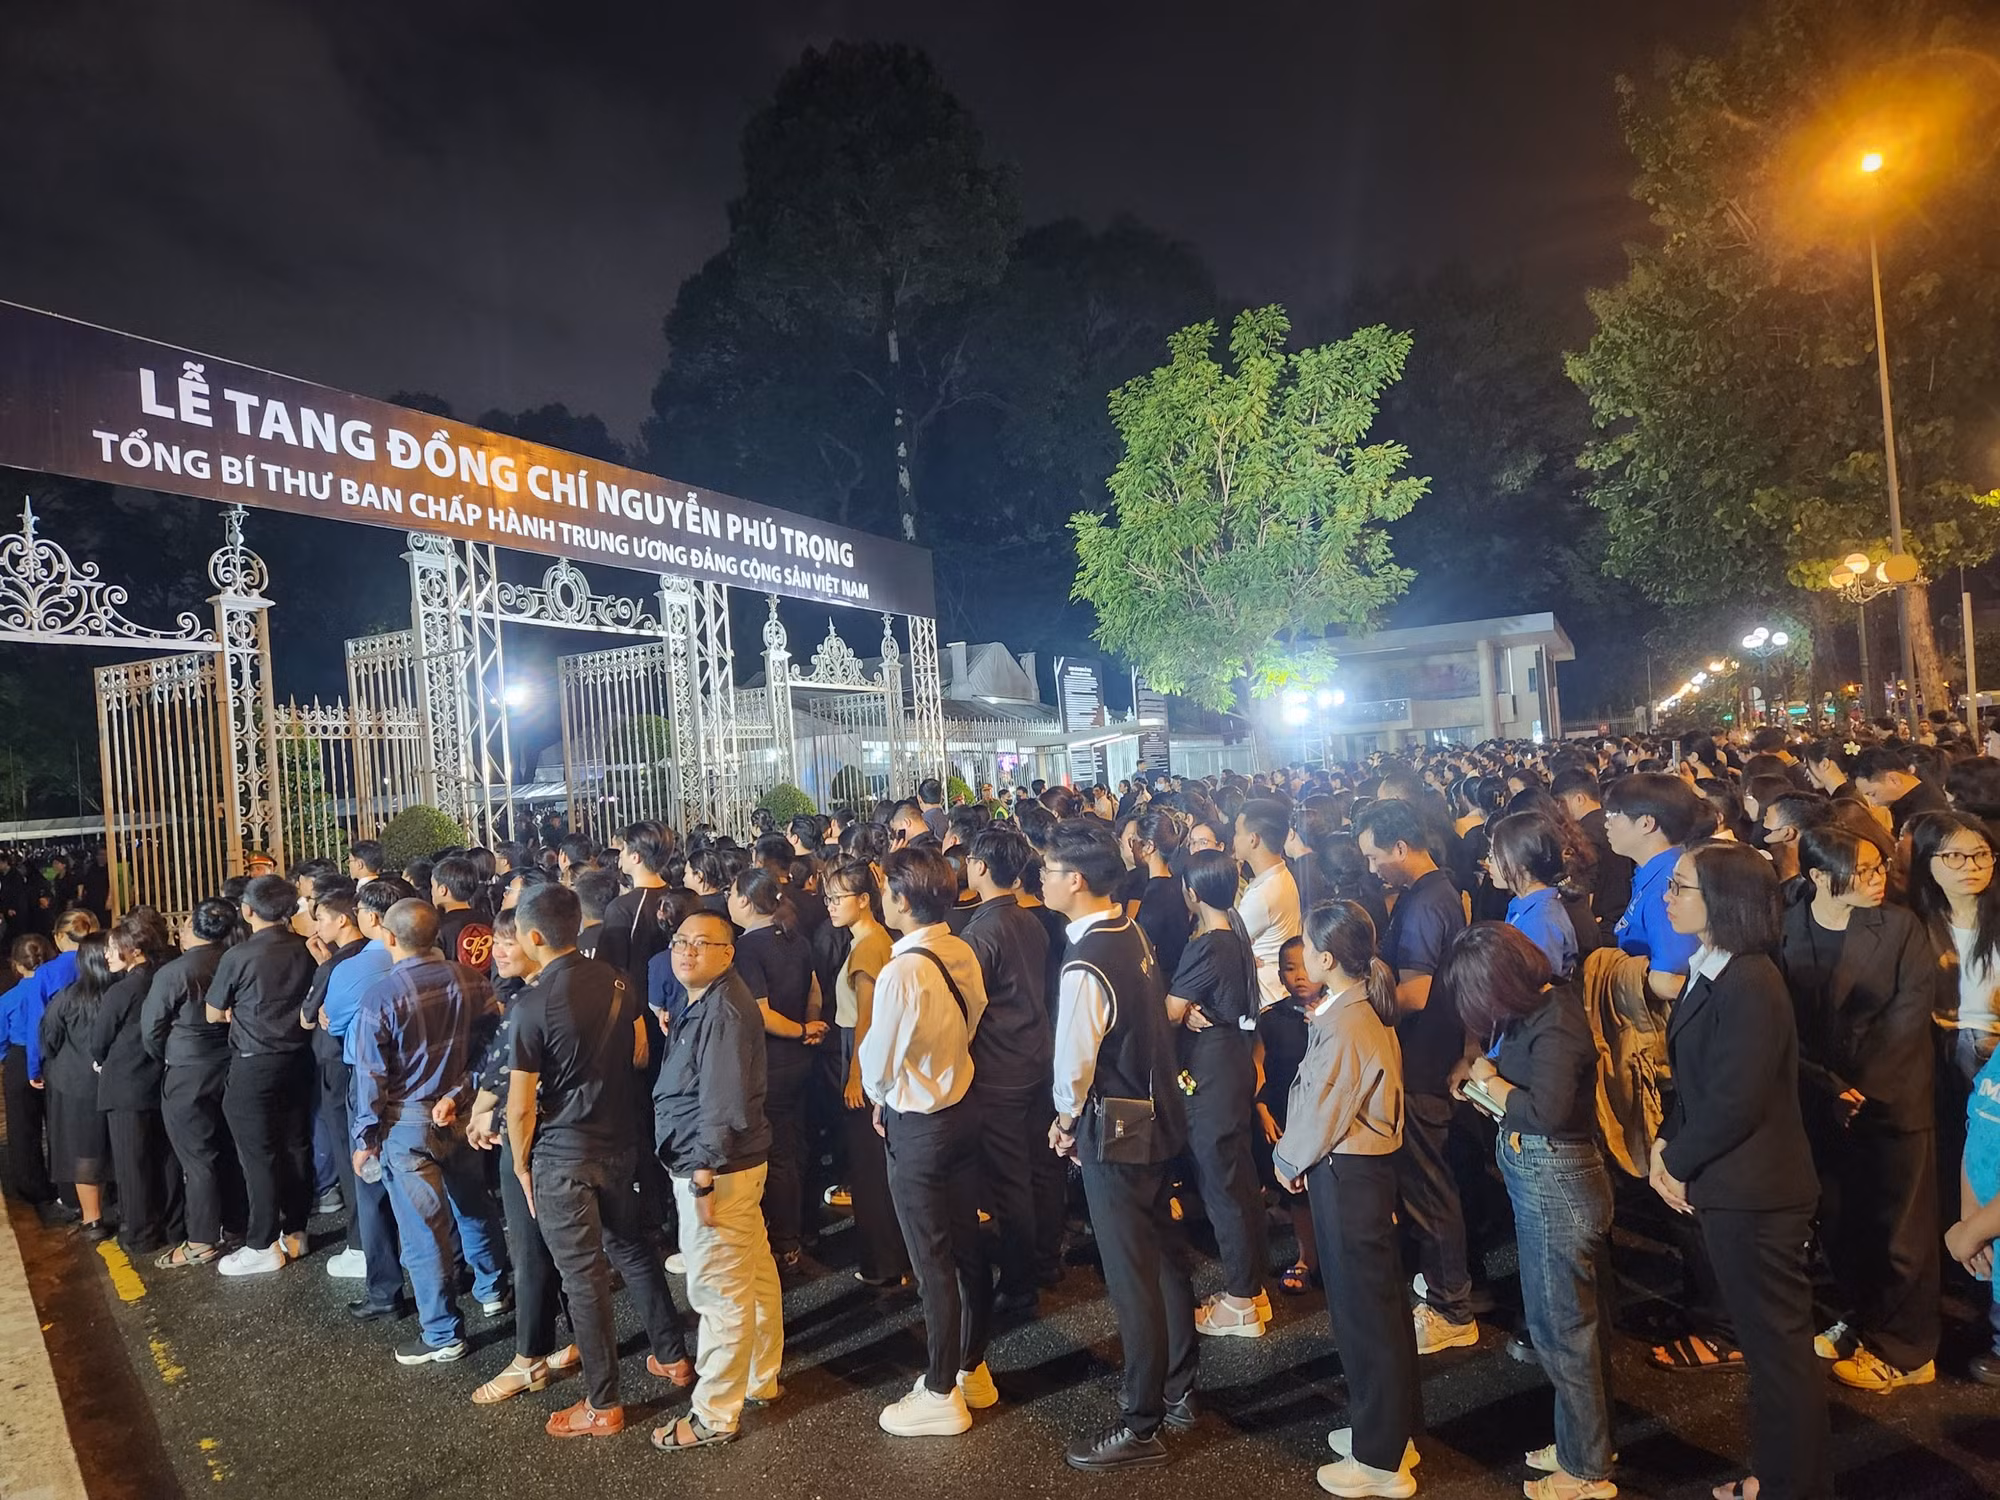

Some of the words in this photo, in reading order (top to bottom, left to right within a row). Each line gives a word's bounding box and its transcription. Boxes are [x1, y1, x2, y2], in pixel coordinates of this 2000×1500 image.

[92, 428, 211, 479] TỔNG
[221, 454, 254, 487] BÍ
[260, 463, 333, 499] THƯ
[341, 478, 403, 513] BAN
[409, 493, 482, 526] CHẤP
[488, 508, 556, 541] HÀNH
[559, 521, 629, 555] TRUNG
[633, 537, 687, 566] ƯƠNG
[690, 547, 737, 575] ĐẢNG
[740, 558, 782, 585] CỘNG
[784, 565, 812, 590] SẢN
[812, 573, 839, 597] VIỆT
[841, 580, 869, 599] NAM
[139, 361, 213, 428] LỄ
[224, 388, 375, 461] TANG
[386, 429, 518, 492] ĐỒNG
[527, 465, 588, 508] CHÍ
[596, 480, 721, 538] NGUYỄN
[726, 513, 776, 550] PHÚ
[780, 526, 854, 568] TRỌNG
